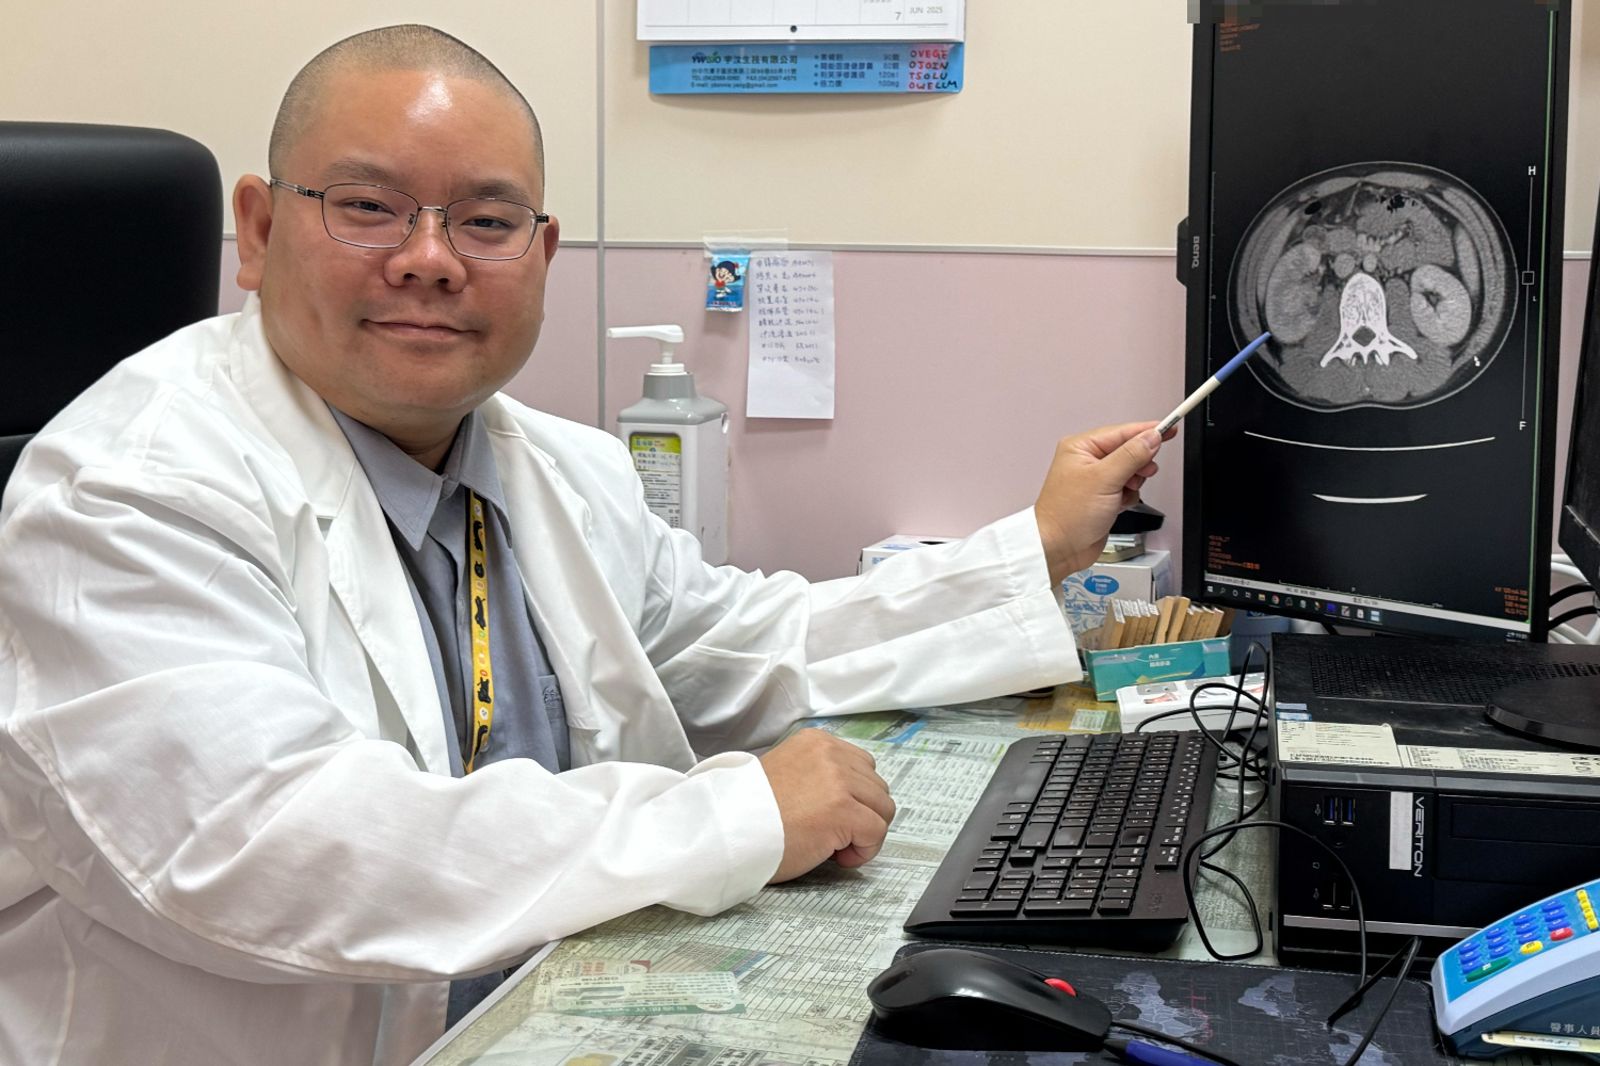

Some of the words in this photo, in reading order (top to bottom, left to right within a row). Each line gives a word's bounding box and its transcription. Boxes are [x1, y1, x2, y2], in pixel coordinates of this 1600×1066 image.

[895, 11, 902, 20] 7
[926, 6, 943, 14] 2025
[1528, 165, 1536, 176] H
[1519, 420, 1527, 431] F
[1414, 796, 1425, 877] VERITON
